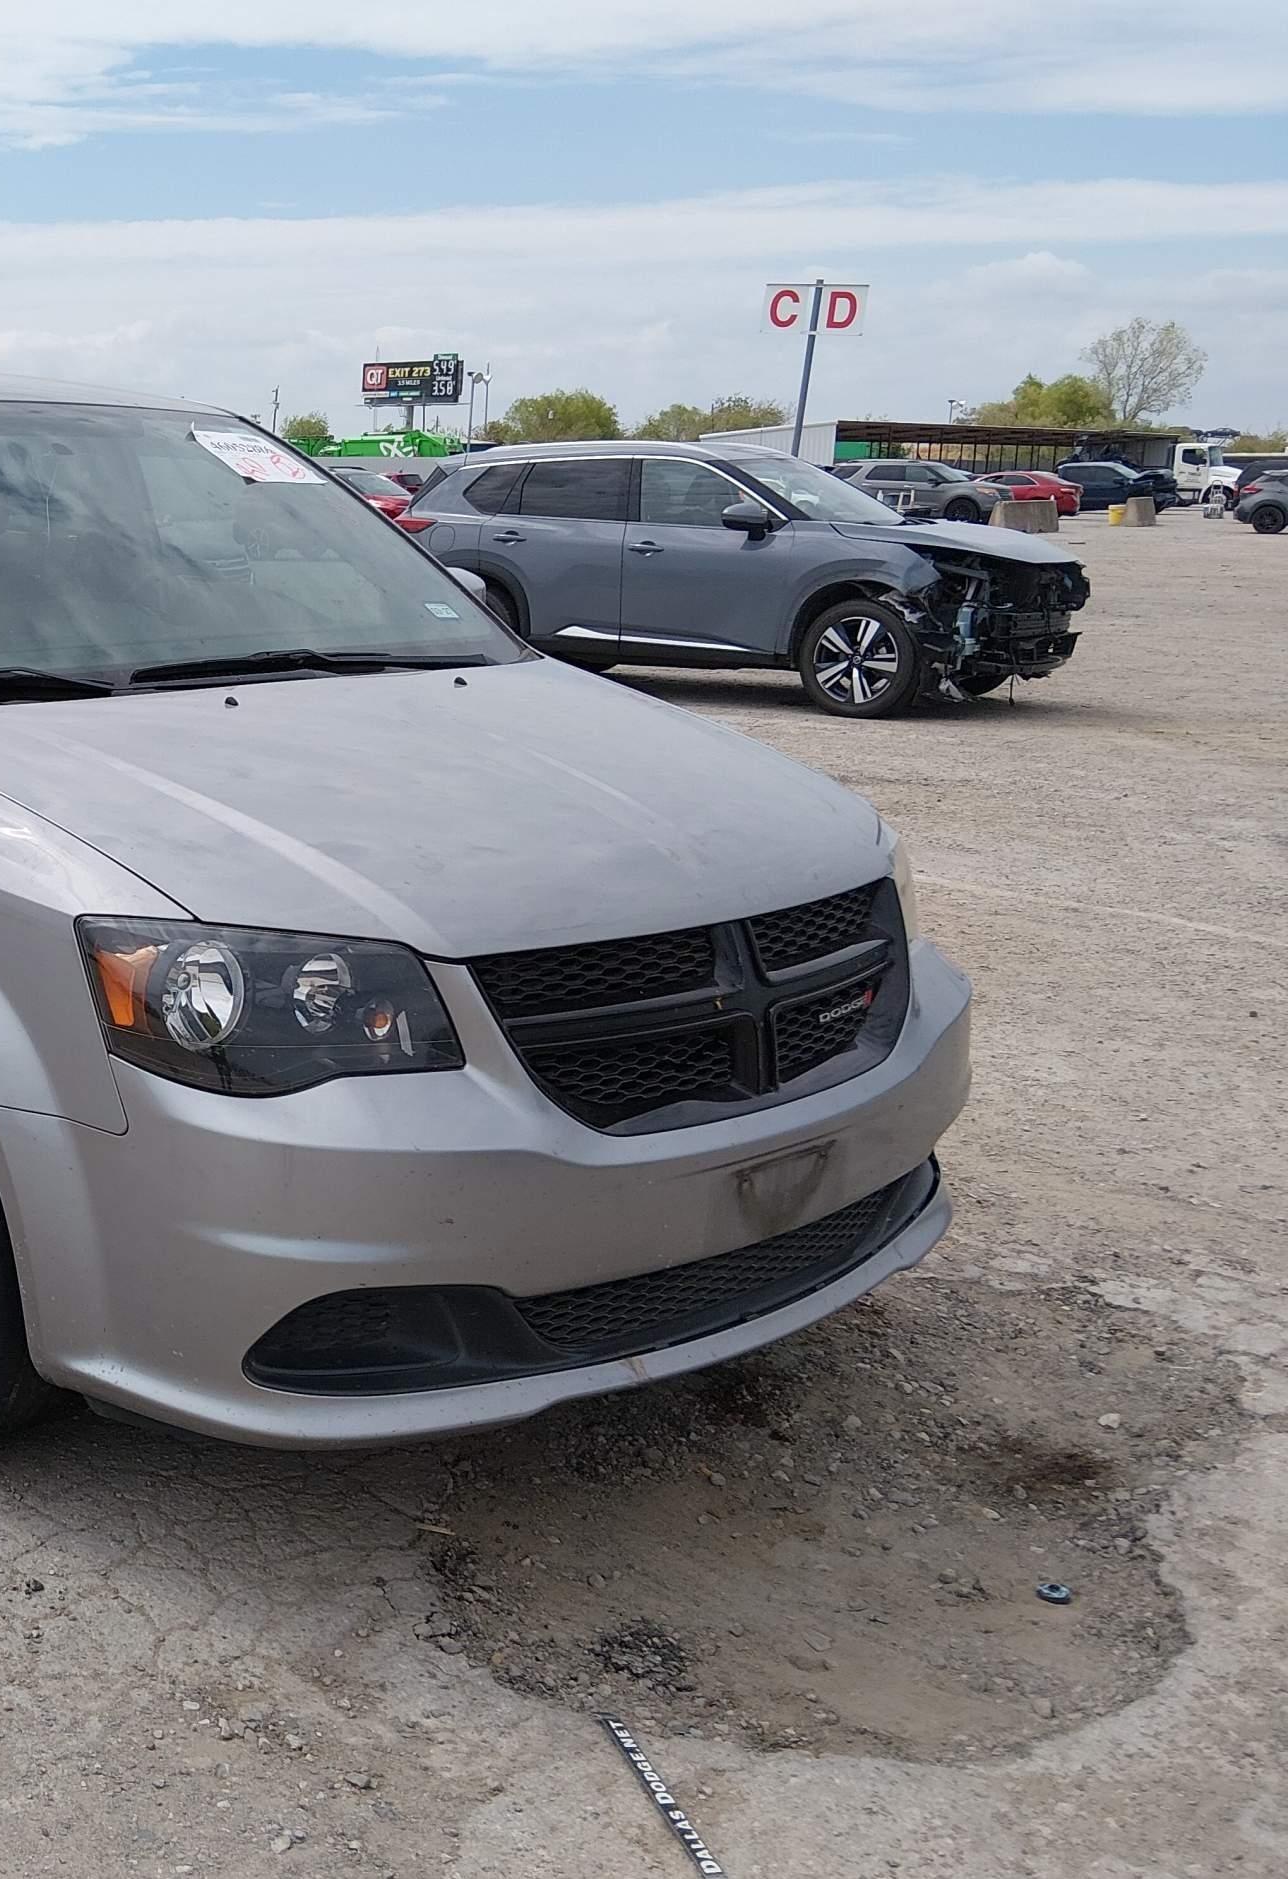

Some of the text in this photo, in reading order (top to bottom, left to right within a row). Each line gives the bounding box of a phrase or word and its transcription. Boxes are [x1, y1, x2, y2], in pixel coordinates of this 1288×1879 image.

[770, 289, 858, 329] C D
[367, 369, 383, 384] QT
[388, 366, 431, 378] EXIT 273
[819, 995, 865, 1022] DODGE
[609, 1720, 723, 1874] DALLAS DODGE.NET
